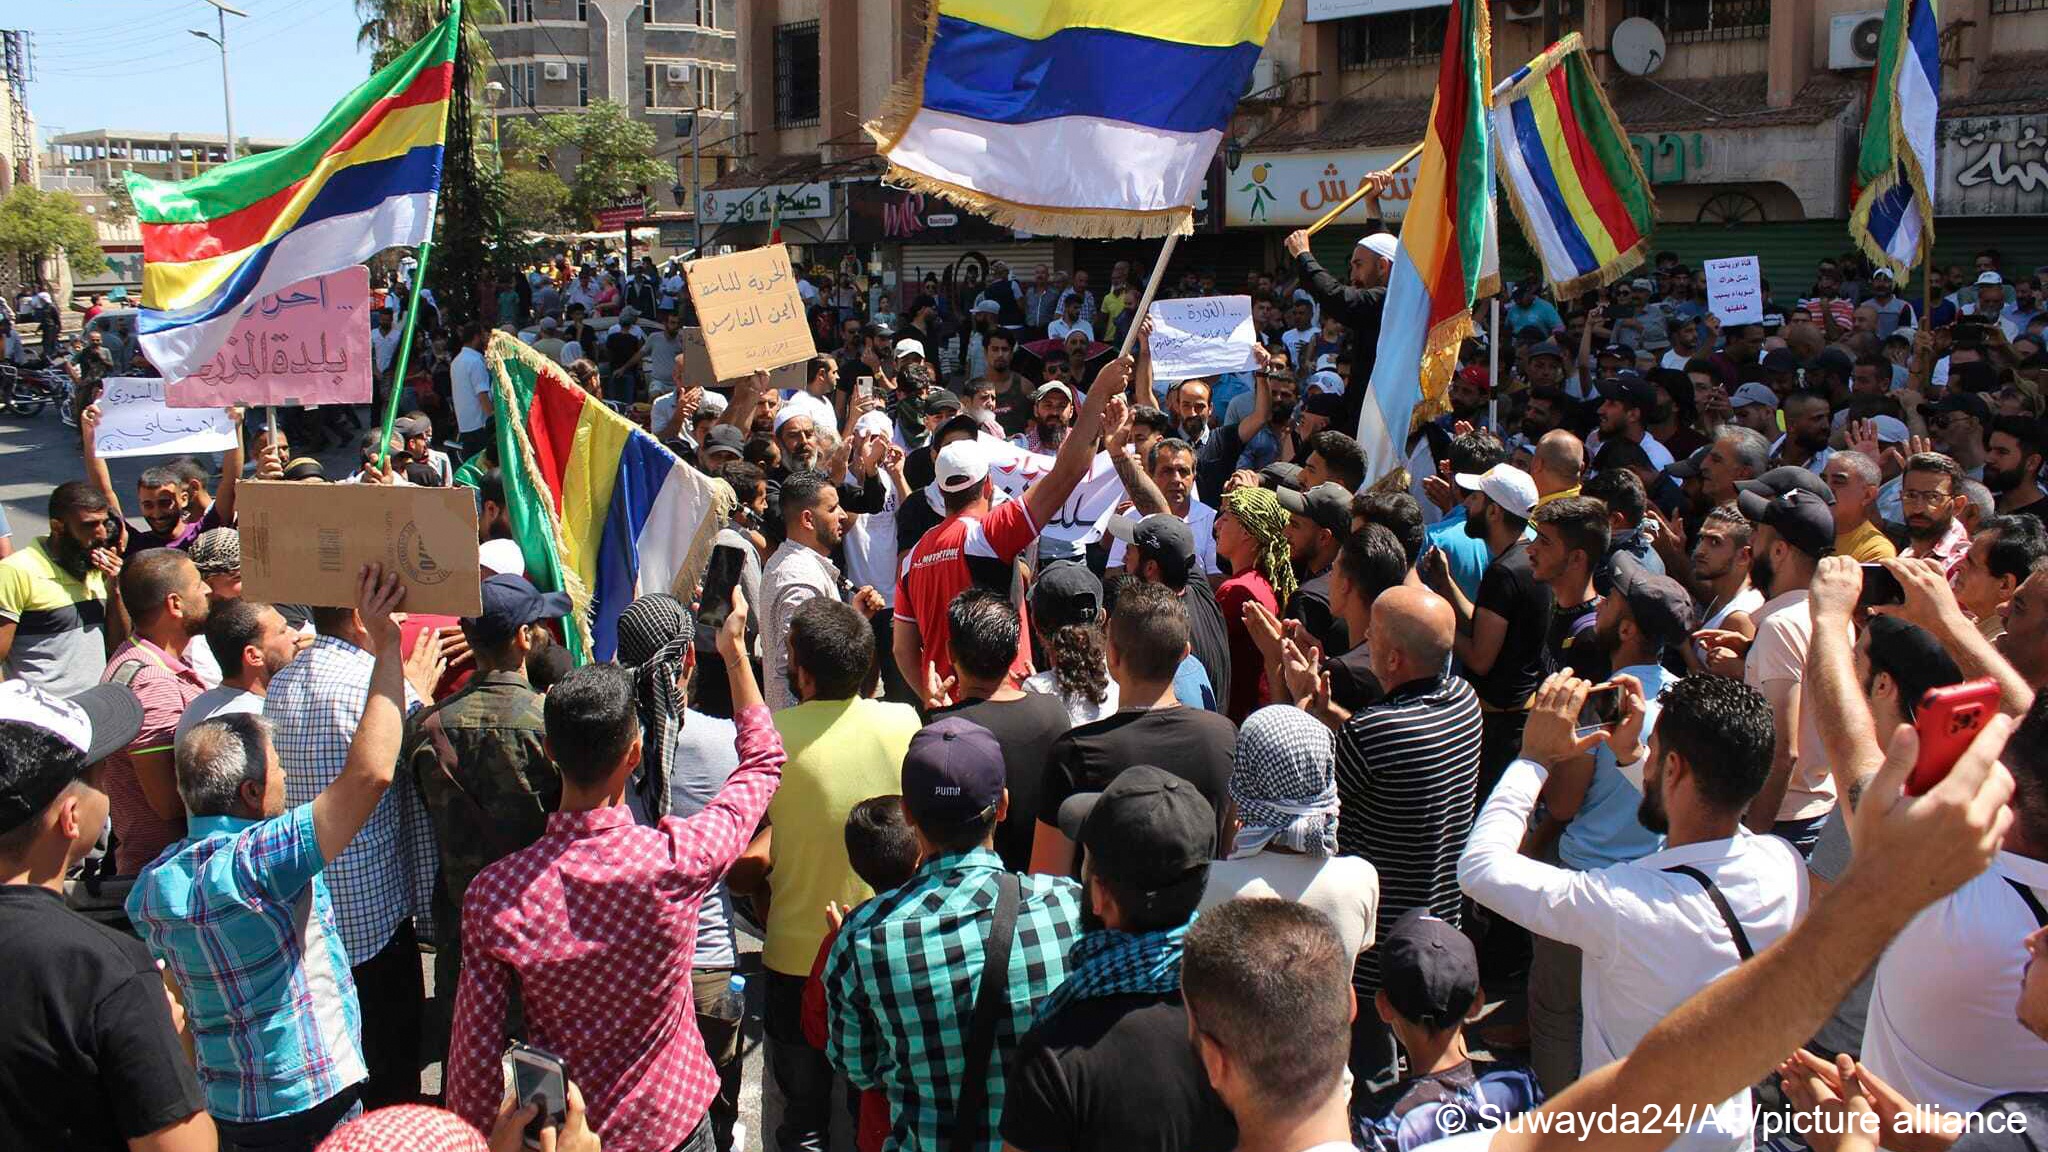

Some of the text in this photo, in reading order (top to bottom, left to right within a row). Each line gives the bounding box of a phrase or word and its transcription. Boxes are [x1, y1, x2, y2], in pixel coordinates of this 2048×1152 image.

[748, 260, 788, 293] الحرية
[706, 305, 763, 335] الفارس
[1187, 300, 1225, 323] الثورة
[272, 331, 348, 386] بلدة
[935, 786, 961, 796] PUMA
